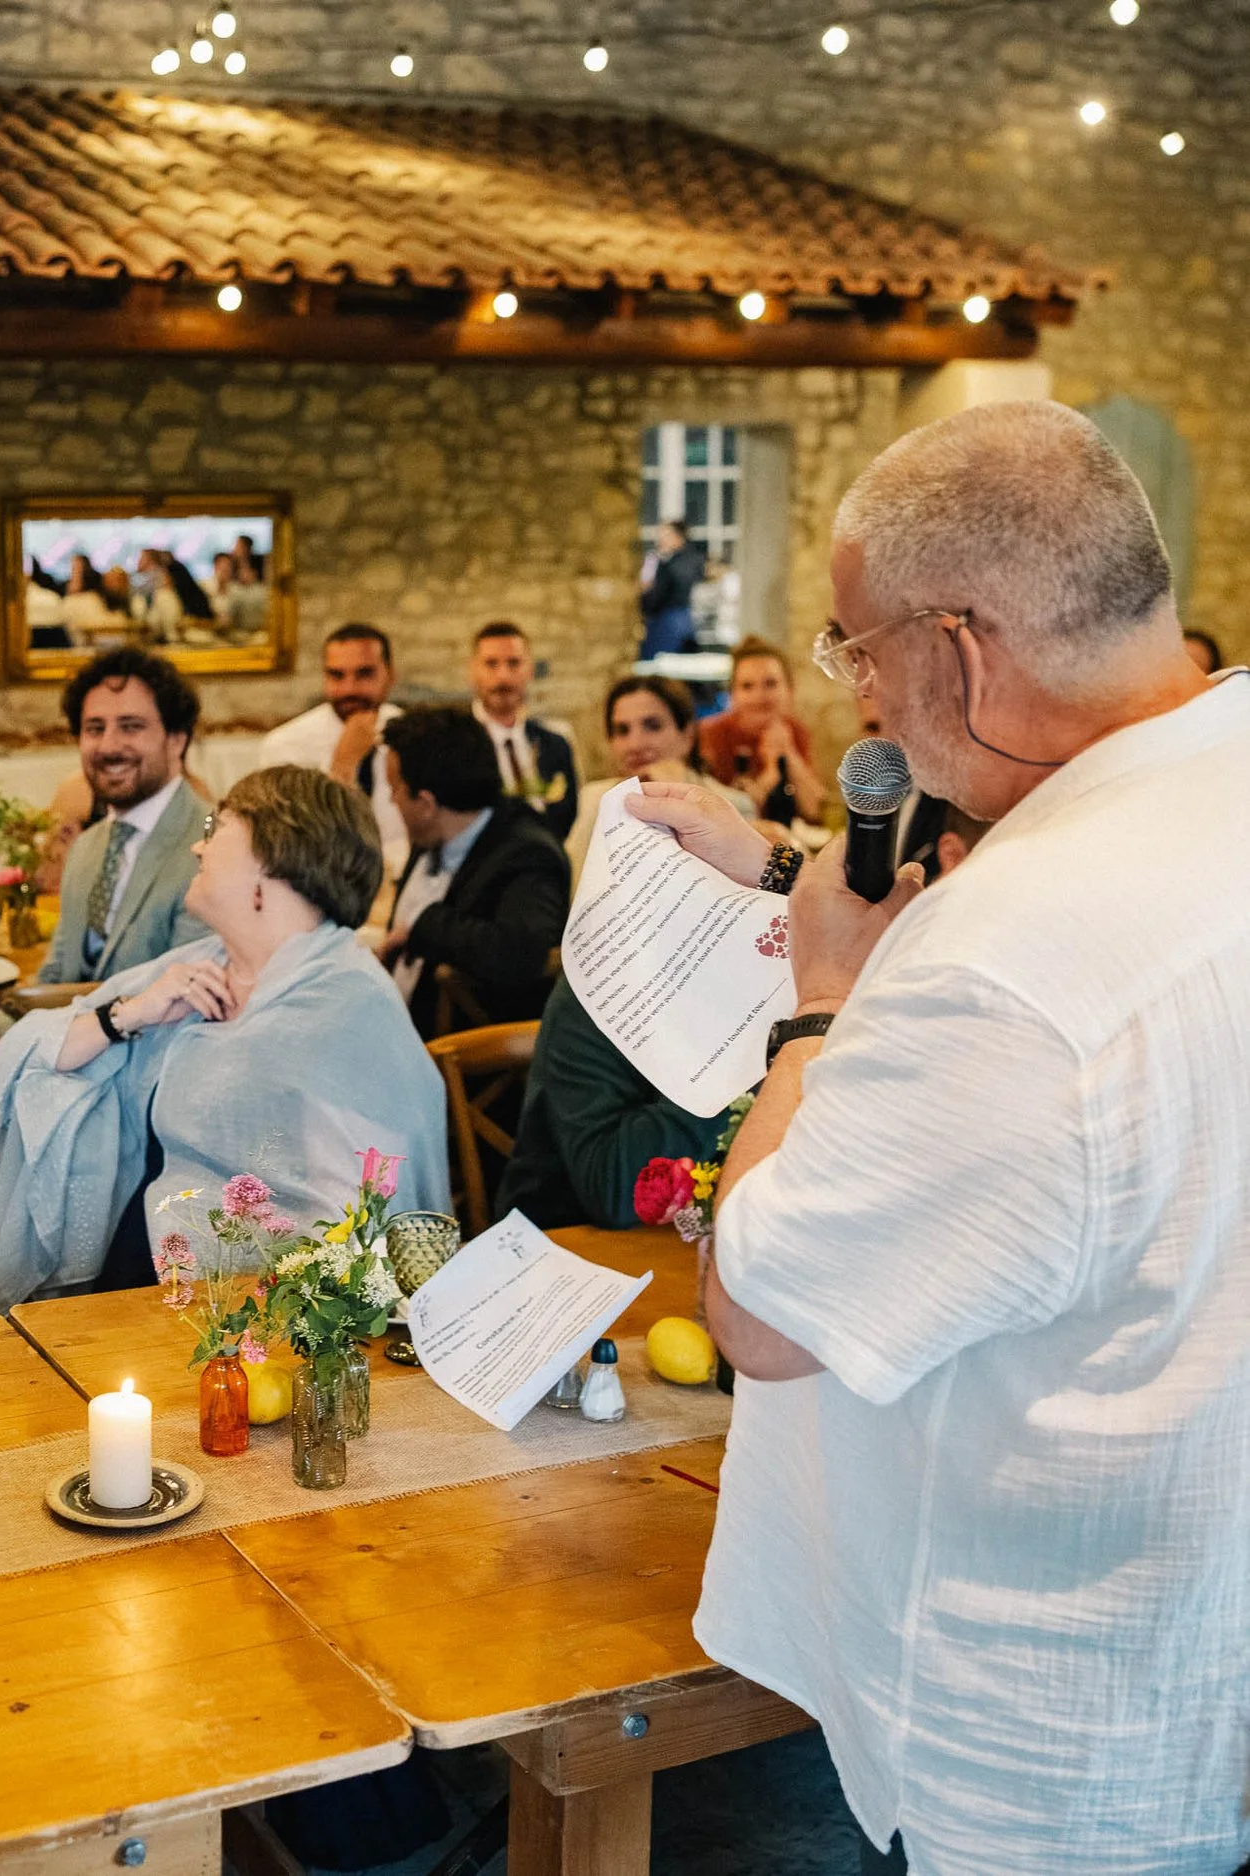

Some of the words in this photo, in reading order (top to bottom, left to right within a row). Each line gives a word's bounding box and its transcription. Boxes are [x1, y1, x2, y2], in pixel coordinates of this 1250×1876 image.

[630, 881, 651, 904] sommes
[648, 869, 661, 882] fiers
[661, 860, 668, 869] de
[642, 895, 653, 905] fait
[651, 875, 669, 896] rentrer
[657, 900, 681, 929] tendresse
[681, 893, 688, 901] et
[617, 988, 644, 1015] maintenant
[643, 979, 653, 990] que
[661, 952, 679, 973] petites
[701, 909, 713, 923] sont
[651, 988, 662, 998] vais
[661, 980, 669, 988] en
[667, 958, 687, 982] profiter
[686, 943, 698, 959] pour
[698, 914, 723, 944] demander
[651, 1001, 665, 1015] verre
[664, 989, 676, 1003] pour
[676, 971, 692, 990] porter
[691, 962, 700, 971] un
[697, 946, 713, 962] toast
[711, 938, 719, 947] au
[716, 914, 739, 939] bonheur
[738, 905, 748, 915] des
[690, 1064, 708, 1083] Bonne
[707, 1046, 725, 1064] soirée
[728, 1021, 748, 1041] toutes
[747, 1013, 754, 1022] et
